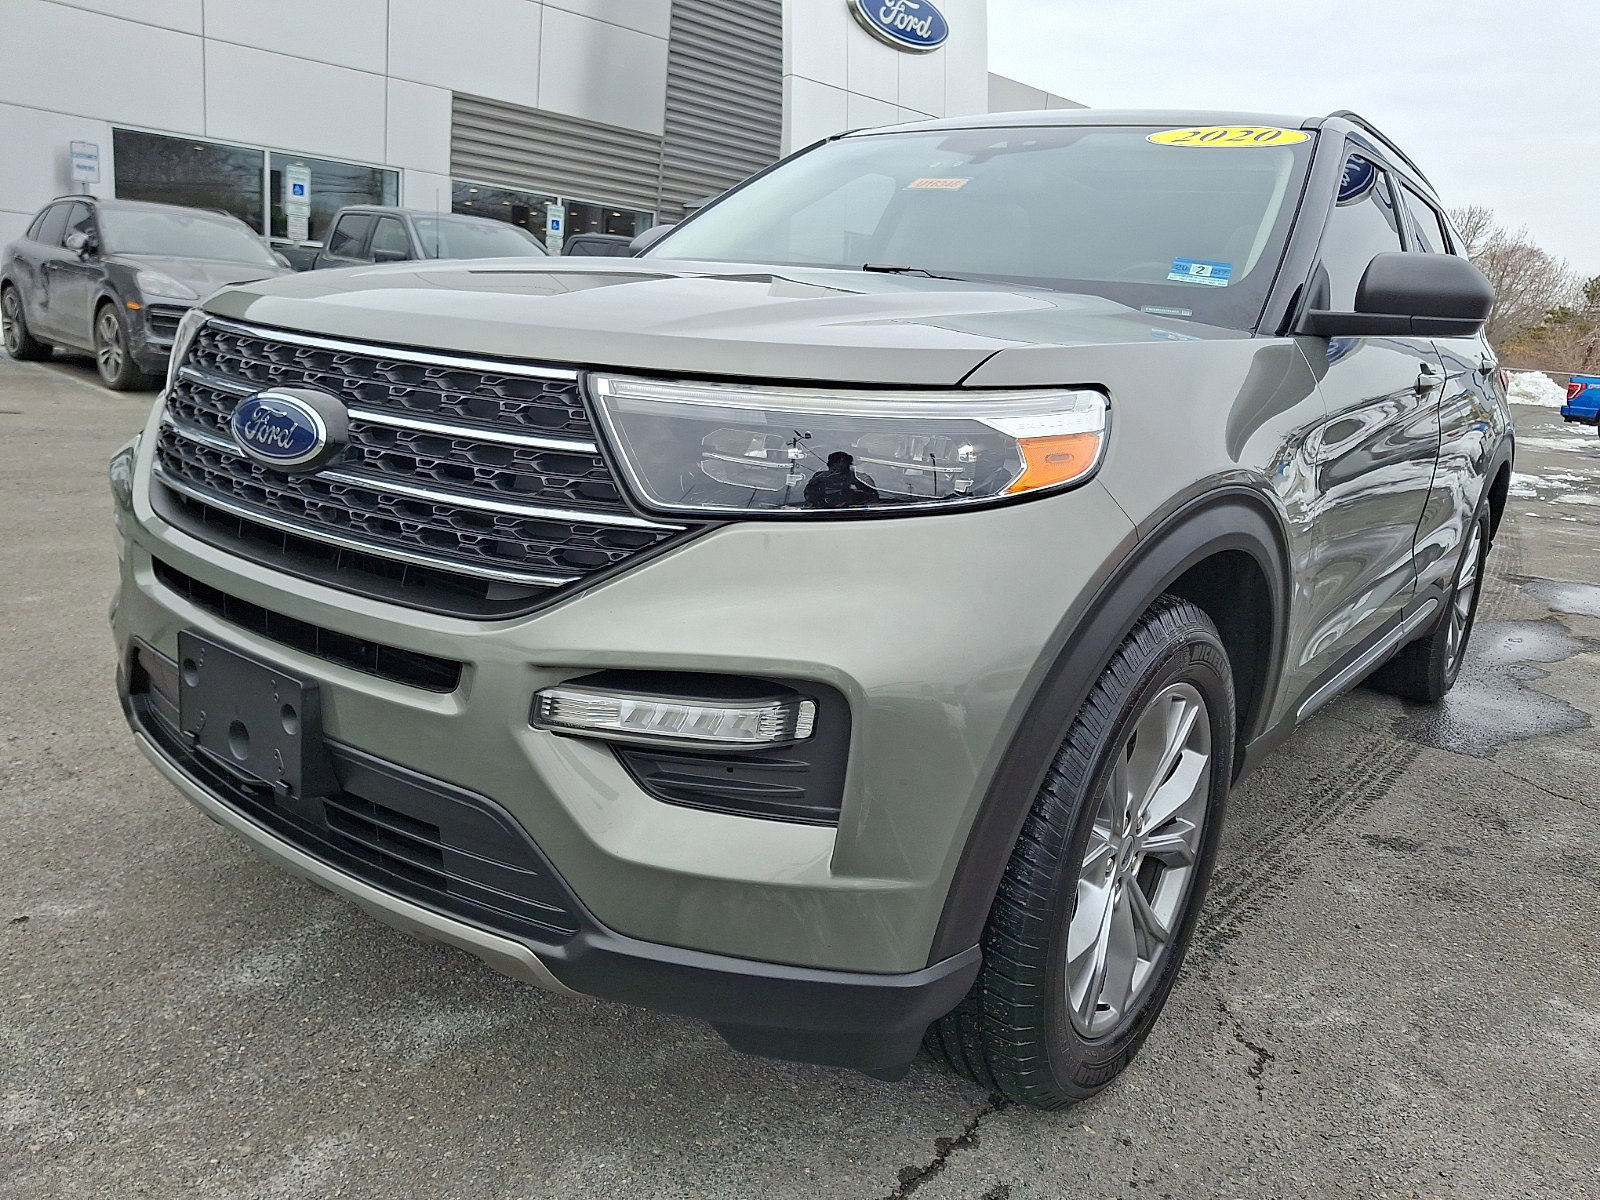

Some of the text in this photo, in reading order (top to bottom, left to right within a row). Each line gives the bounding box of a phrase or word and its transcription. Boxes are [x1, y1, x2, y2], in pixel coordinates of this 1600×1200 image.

[880, 0, 932, 38] Ford
[1170, 130, 1282, 142] 2020
[1195, 265, 1206, 275] 2
[244, 405, 299, 449] Ford
